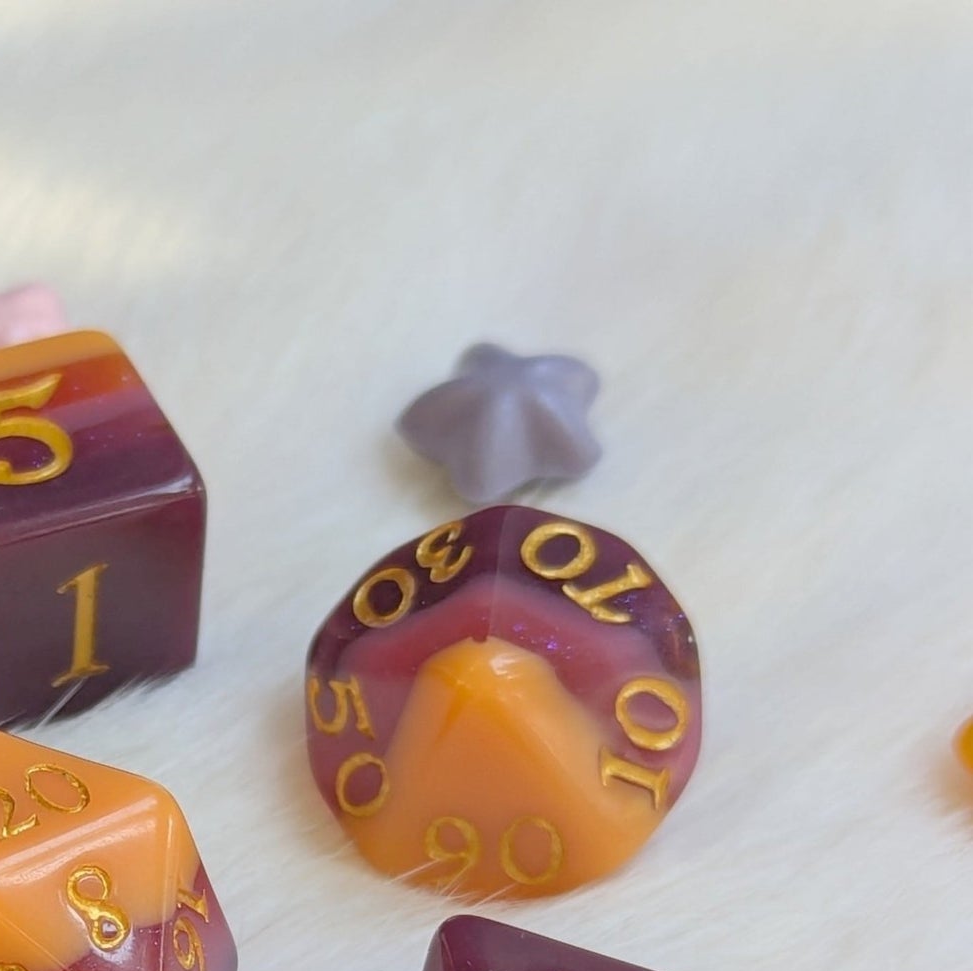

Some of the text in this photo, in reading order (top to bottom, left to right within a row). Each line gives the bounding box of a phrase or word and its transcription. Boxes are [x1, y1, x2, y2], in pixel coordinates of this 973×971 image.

[51, 563, 110, 688] 1
[353, 520, 475, 629] 30
[307, 674, 391, 818] 50
[599, 675, 689, 812] 10
[67, 864, 130, 953] 8
